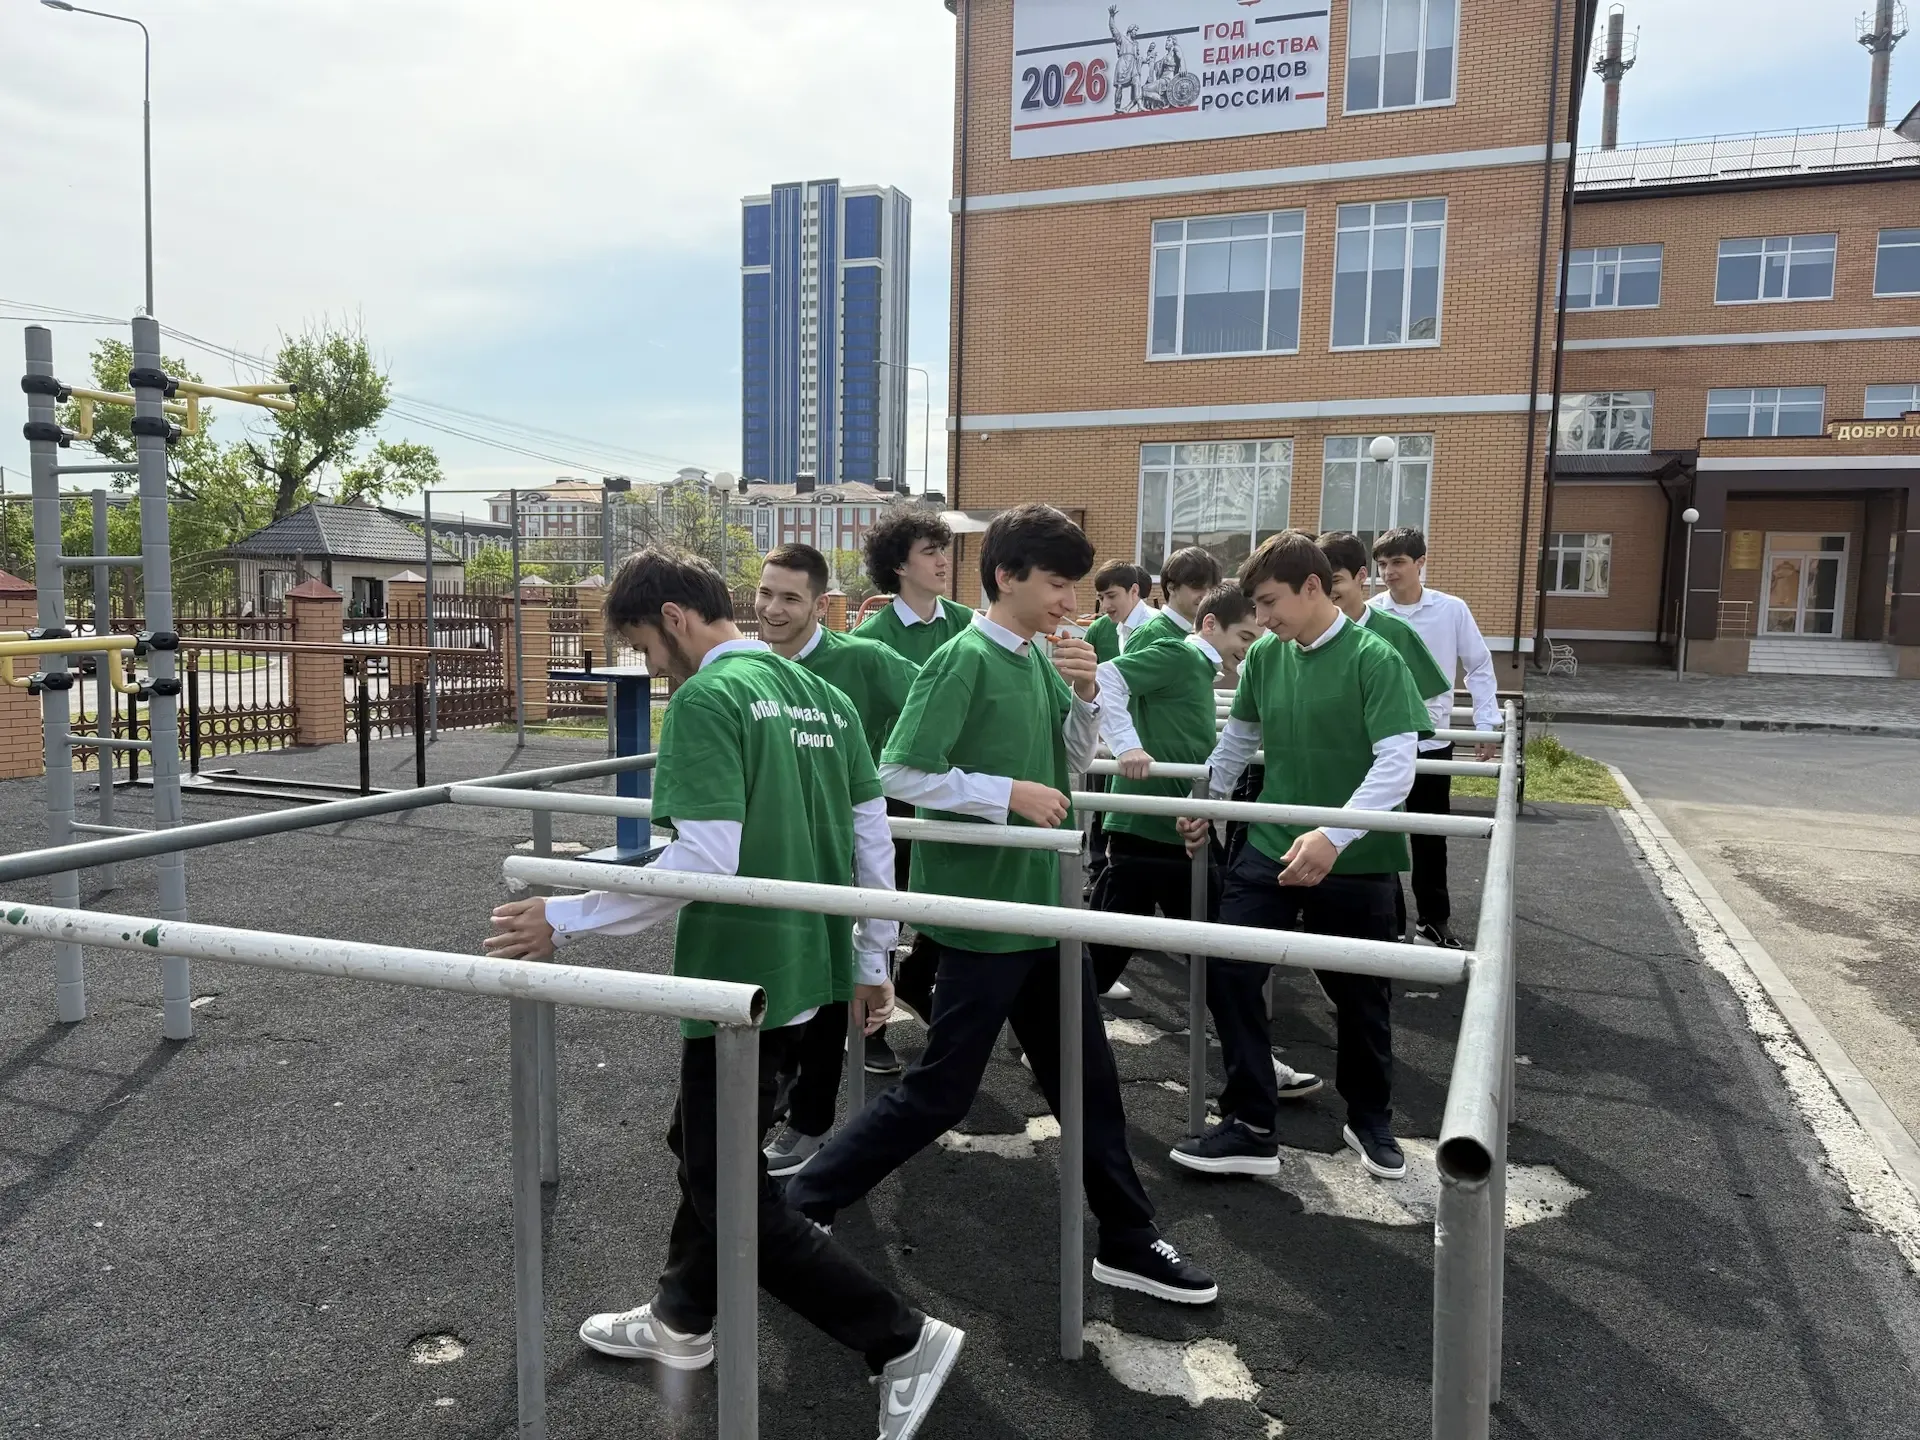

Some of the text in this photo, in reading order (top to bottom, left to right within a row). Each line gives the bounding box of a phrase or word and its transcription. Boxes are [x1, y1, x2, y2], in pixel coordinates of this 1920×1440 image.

[1204, 20, 1244, 40] ГОД
[1203, 36, 1319, 65] ЕДИНСТВА
[1020, 58, 1106, 110] 2026
[1202, 61, 1307, 87] НАРОДОВ
[1201, 86, 1290, 111] РОССИИ
[1837, 425, 1899, 441] ДОБРО
